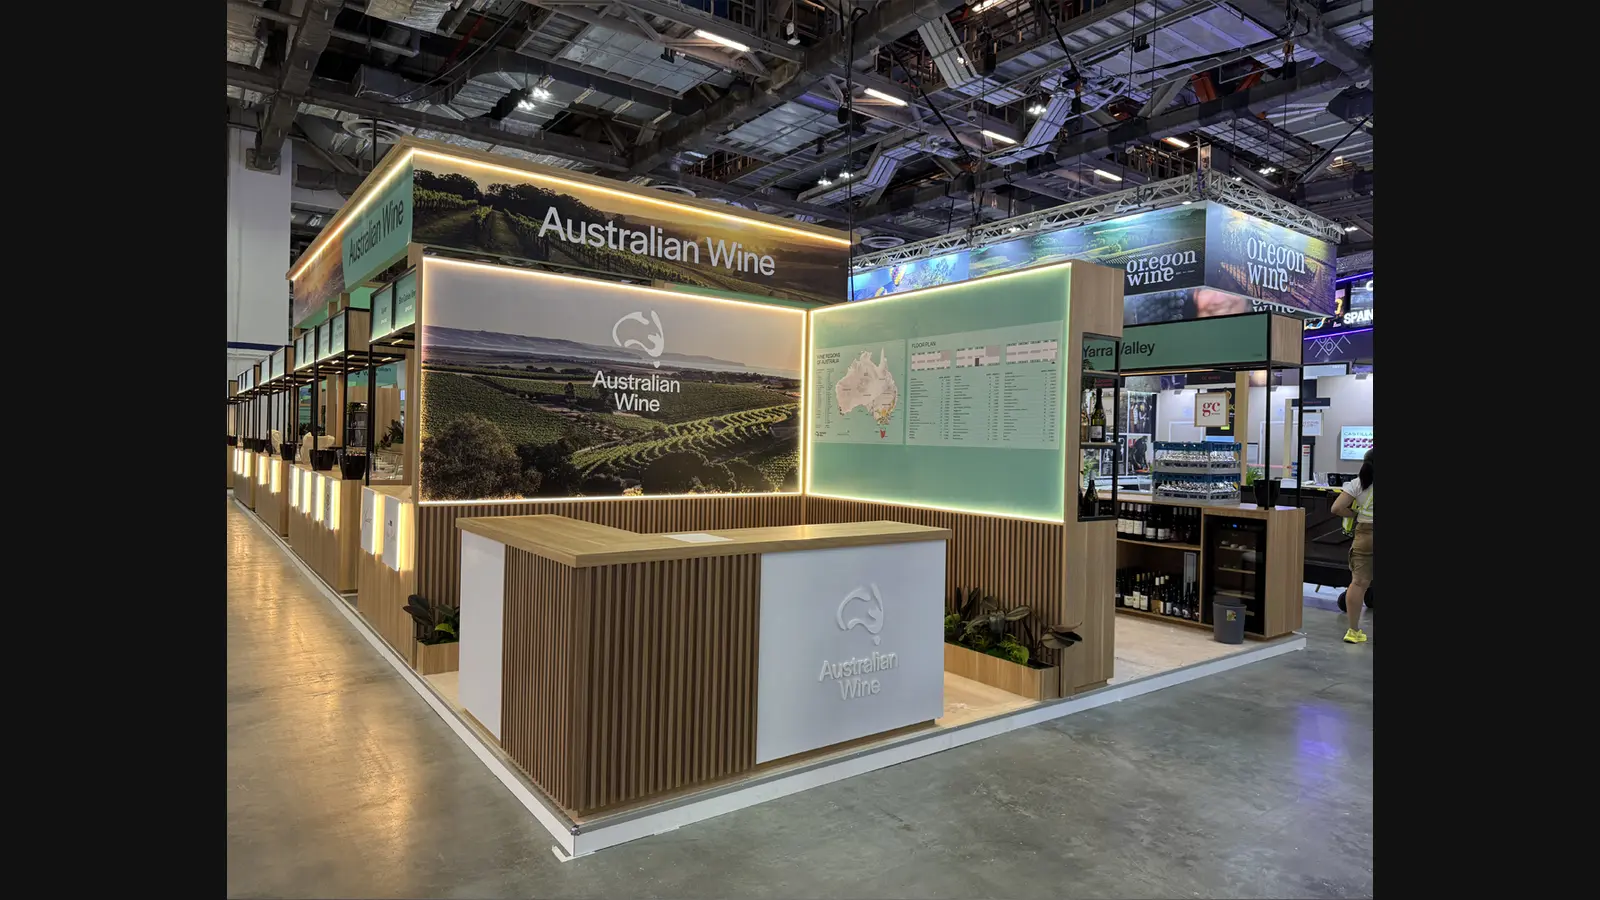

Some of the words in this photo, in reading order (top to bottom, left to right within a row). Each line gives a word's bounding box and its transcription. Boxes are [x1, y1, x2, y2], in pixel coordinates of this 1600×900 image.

[348, 220, 381, 266] Australian
[382, 199, 404, 238] Wine
[538, 206, 699, 264] Australian
[706, 236, 775, 277] Wine
[1127, 267, 1174, 287] wine
[1247, 262, 1288, 293] wine
[1343, 308, 1373, 325] SPAIN
[1083, 345, 1113, 358] Yarra
[592, 370, 680, 393] Australian
[614, 392, 660, 412] Wine
[1202, 402, 1221, 418] gc
[818, 651, 899, 683] Australian
[838, 679, 881, 701] Wine
